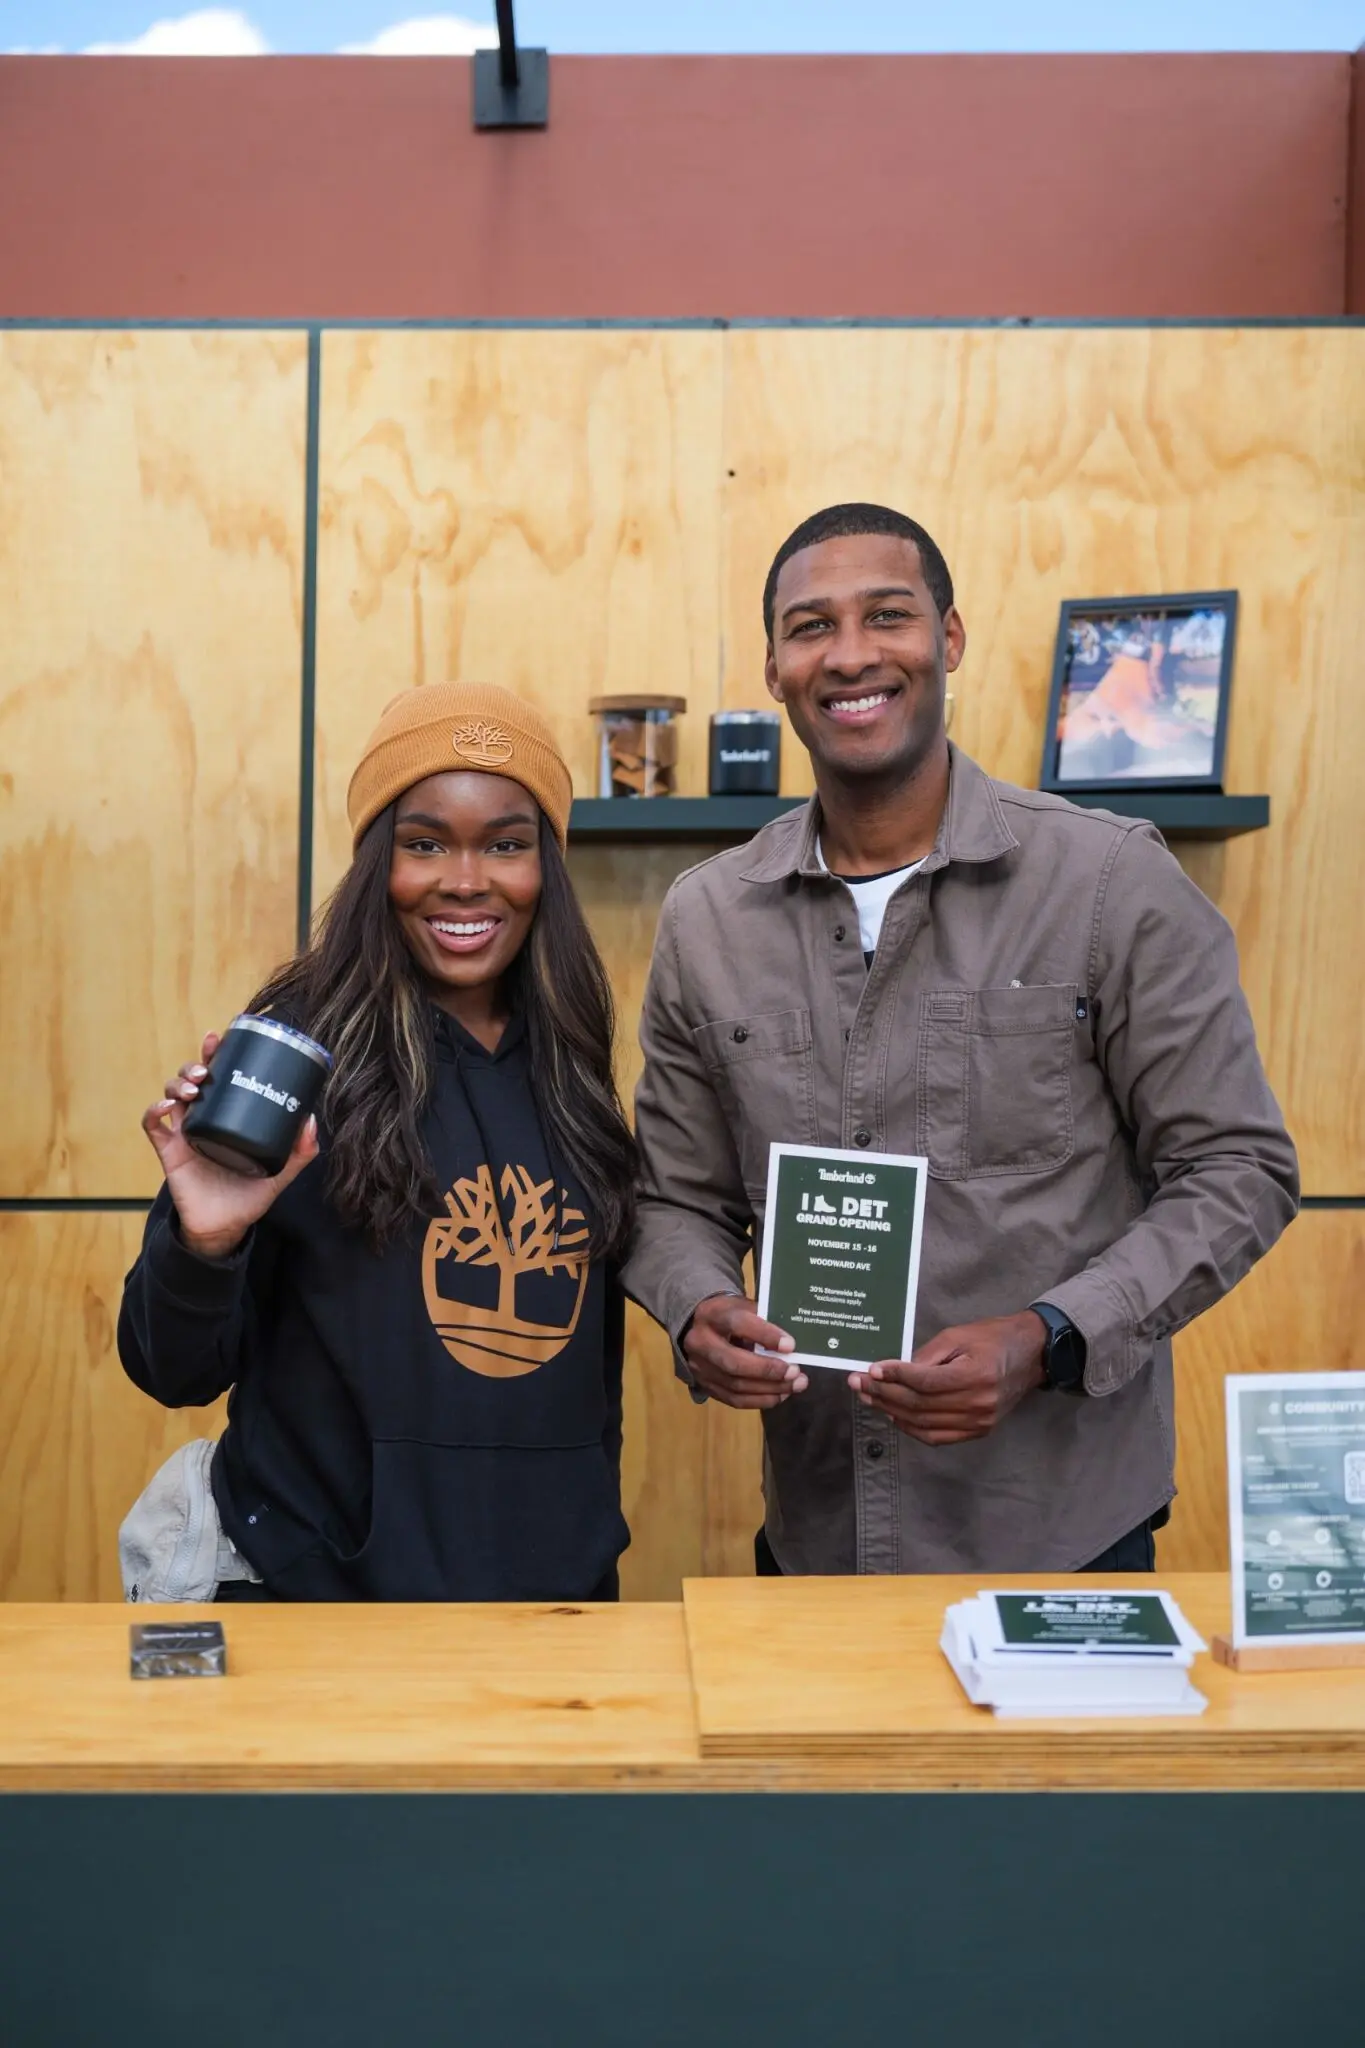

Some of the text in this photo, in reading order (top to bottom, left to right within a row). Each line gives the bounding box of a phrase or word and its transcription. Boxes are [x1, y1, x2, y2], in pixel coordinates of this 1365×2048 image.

[230, 1068, 288, 1107] Timberland
[818, 1168, 864, 1184] Timberland
[801, 1192, 889, 1219] I DET
[796, 1212, 892, 1232] GRAND OPENING
[807, 1238, 850, 1250] NOVEMBER
[852, 1243, 862, 1251] 15
[809, 1257, 871, 1271] WOODWARD AVE
[824, 1287, 853, 1297] Storewide
[853, 1290, 867, 1298] Sale
[846, 1298, 862, 1307] apply
[798, 1307, 811, 1315] Free
[811, 1309, 852, 1320] customization
[864, 1315, 875, 1323] gift
[804, 1317, 830, 1325] purchase
[830, 1319, 845, 1328] while
[845, 1321, 869, 1330] supplies
[869, 1323, 880, 1332] last
